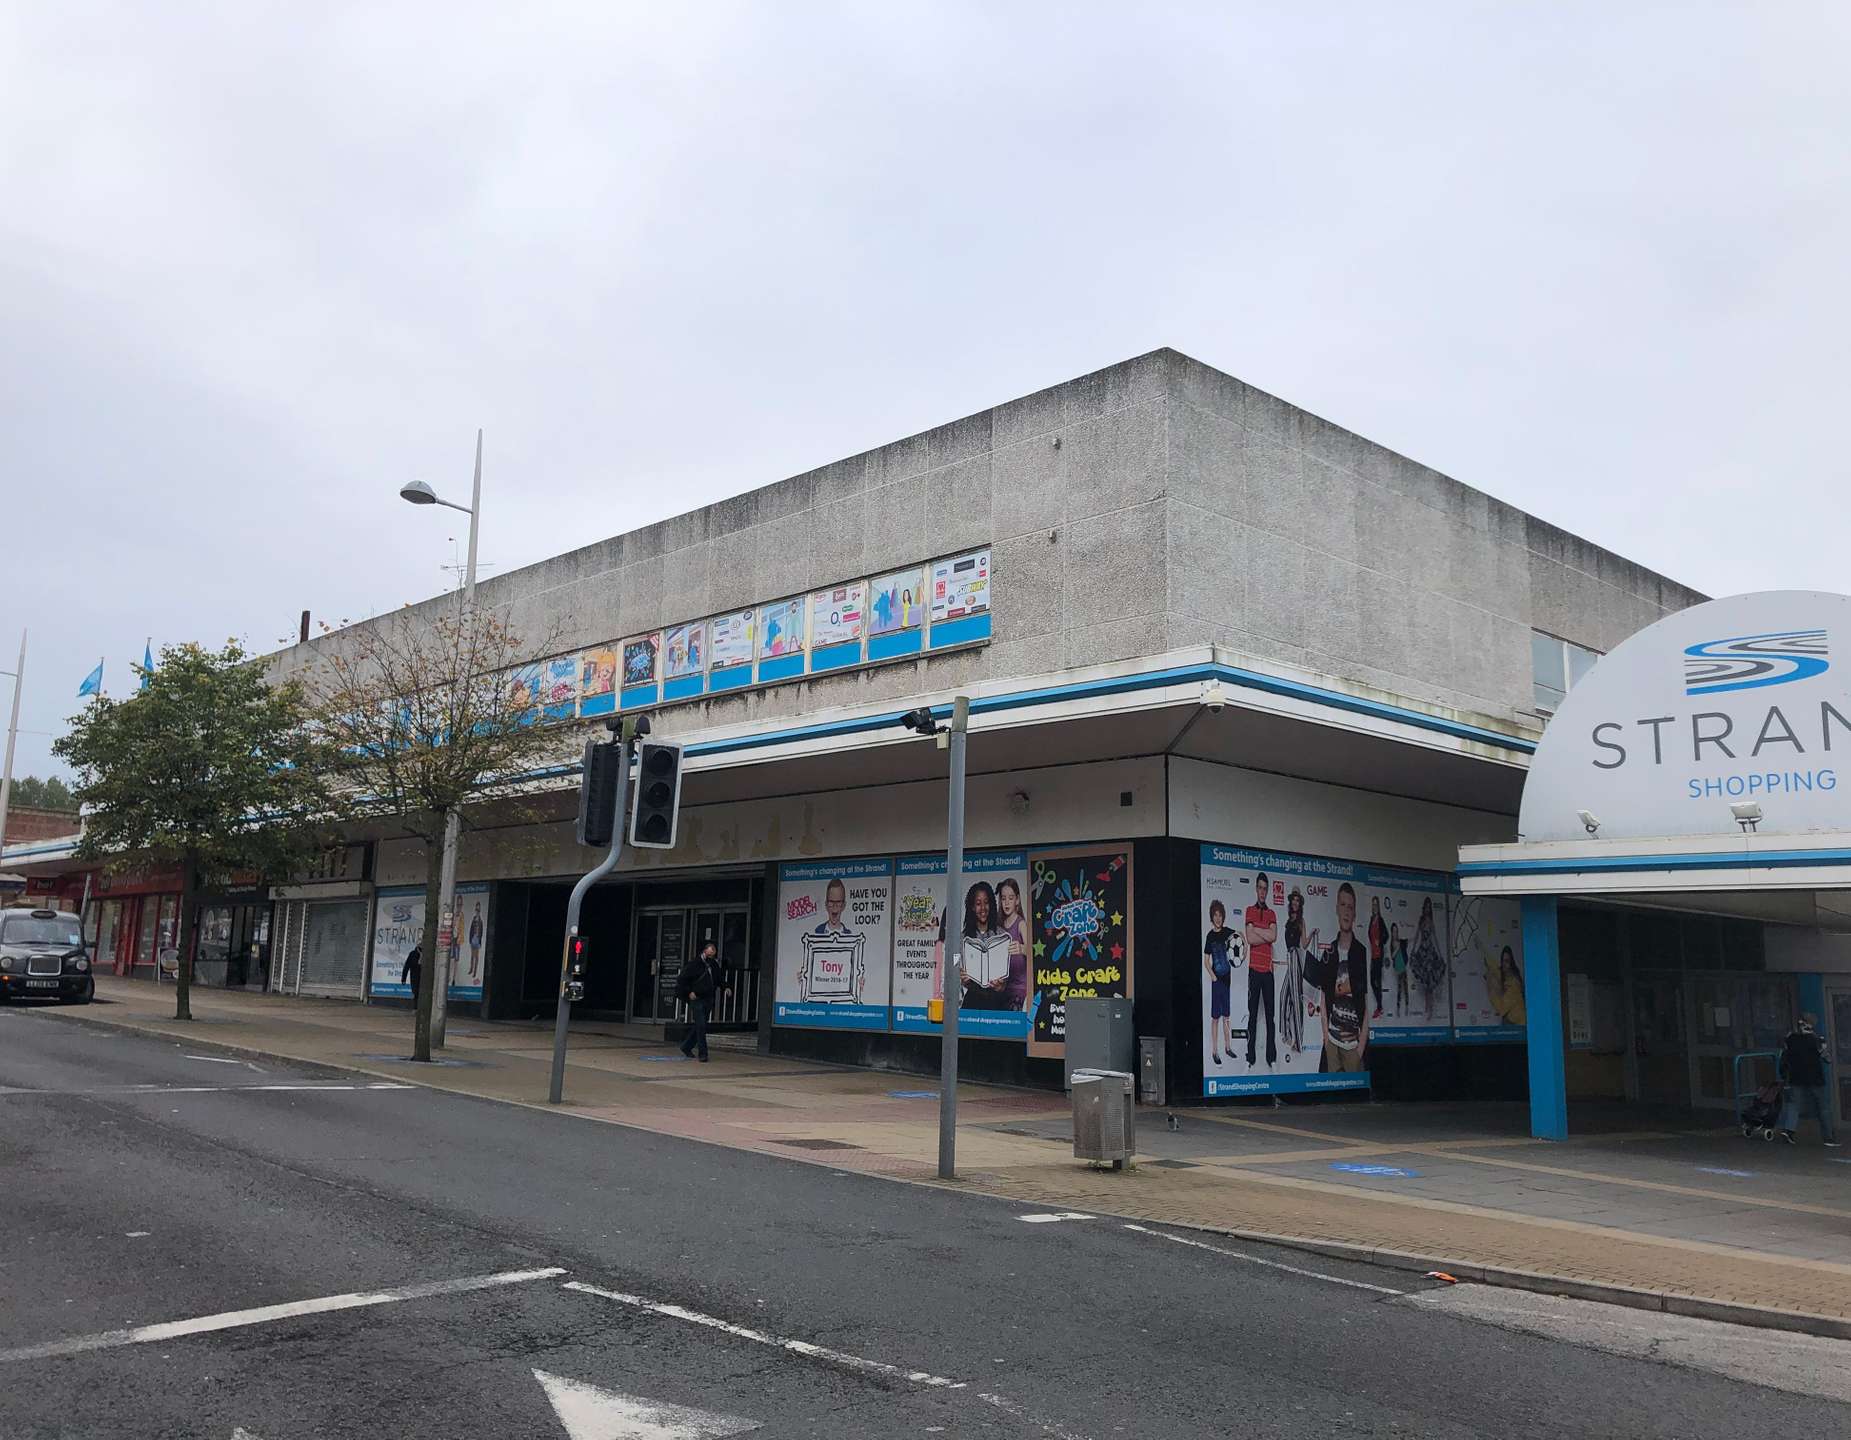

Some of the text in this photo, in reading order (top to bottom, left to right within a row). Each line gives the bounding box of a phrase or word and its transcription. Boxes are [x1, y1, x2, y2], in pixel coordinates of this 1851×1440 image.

[1689, 770, 1836, 798] SHOPPING
[901, 861, 940, 871] Something's
[982, 858, 994, 866] the
[1213, 848, 1264, 868] Something's
[1266, 855, 1302, 872] changing
[1304, 862, 1312, 870] at
[1312, 862, 1326, 872] the
[785, 869, 818, 878] Something's
[820, 867, 846, 876] changing
[865, 864, 886, 872] Strand!
[850, 888, 887, 898] HAVE YOU
[1307, 885, 1328, 897] GAME
[852, 902, 884, 912] GOT THE
[1053, 901, 1097, 928] Craft
[855, 915, 880, 925] LOOK?
[1070, 920, 1098, 936] Zone
[821, 960, 843, 975] Tony
[1037, 966, 1120, 984] Kids Craft
[1060, 986, 1098, 1001] Zone
